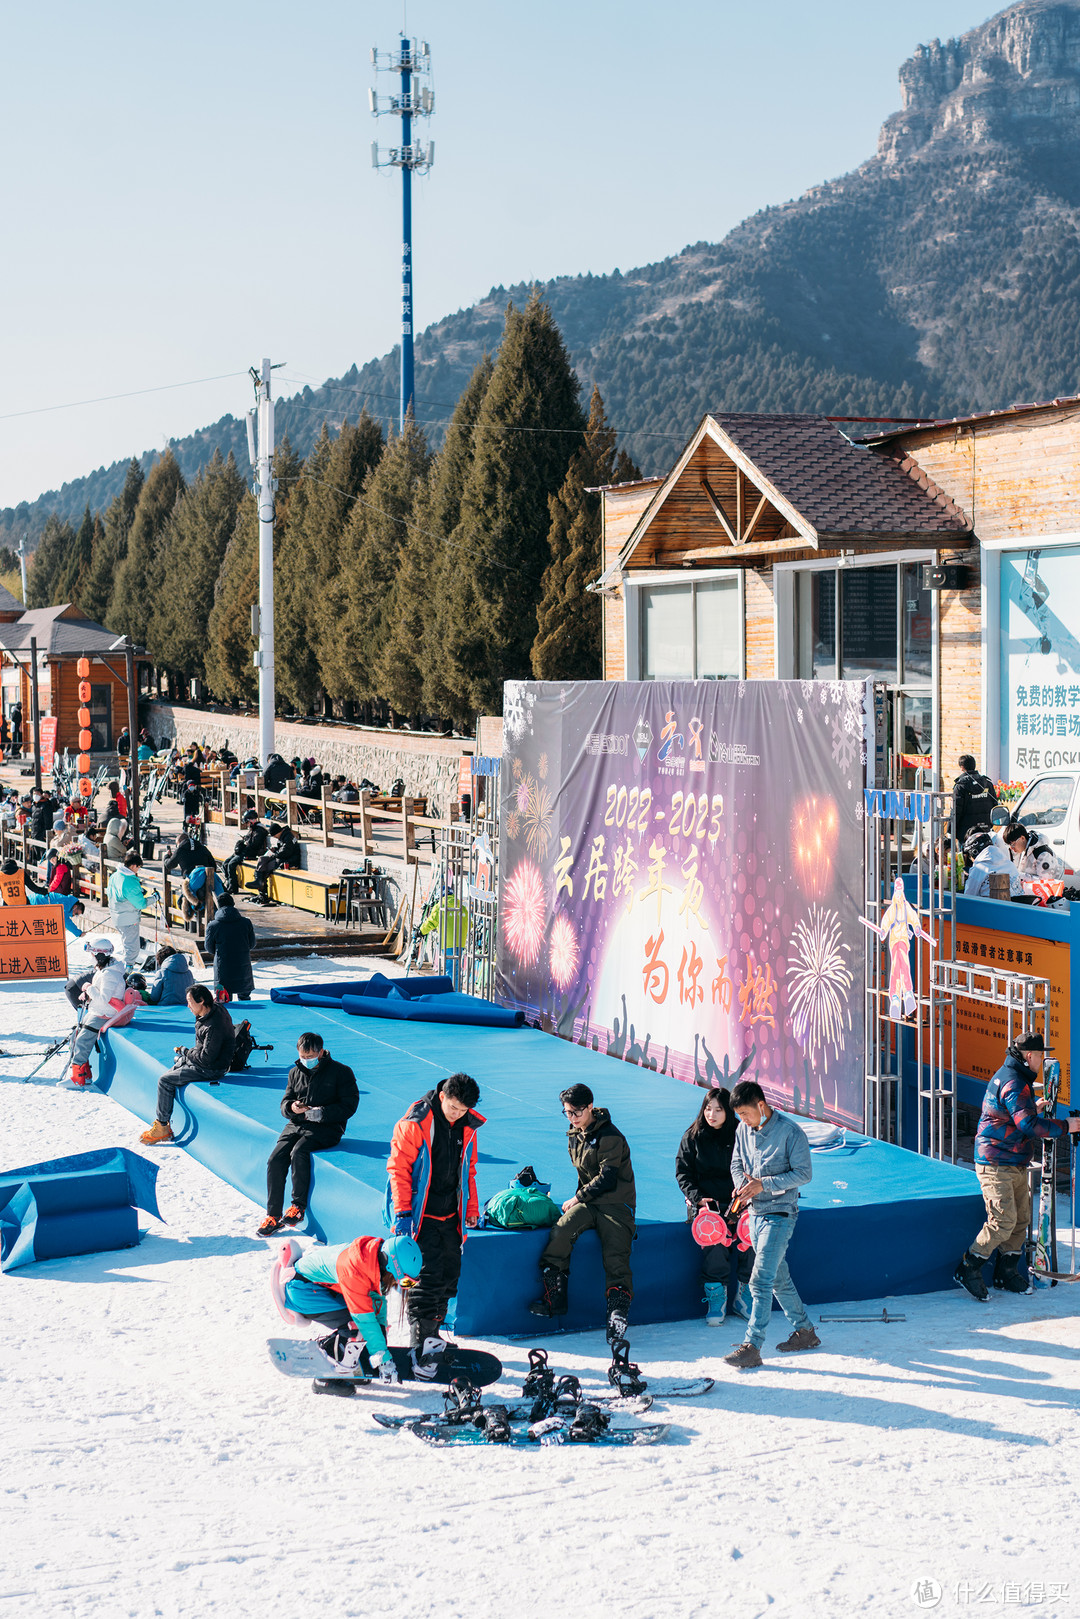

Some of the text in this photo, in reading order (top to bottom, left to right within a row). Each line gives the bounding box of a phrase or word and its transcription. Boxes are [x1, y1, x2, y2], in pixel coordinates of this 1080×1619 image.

[400, 262, 411, 335] 中国联通
[1016, 684, 1080, 707] 免费的教学
[1016, 713, 1080, 737] 精彩的雪场
[1016, 747, 1040, 769] 尽在
[604, 783, 724, 841] 2022-2023
[863, 788, 930, 822] YUNJU
[7, 886, 20, 898] 93
[553, 835, 709, 930] 云居跨年夜
[642, 927, 778, 1027] 为你而燃
